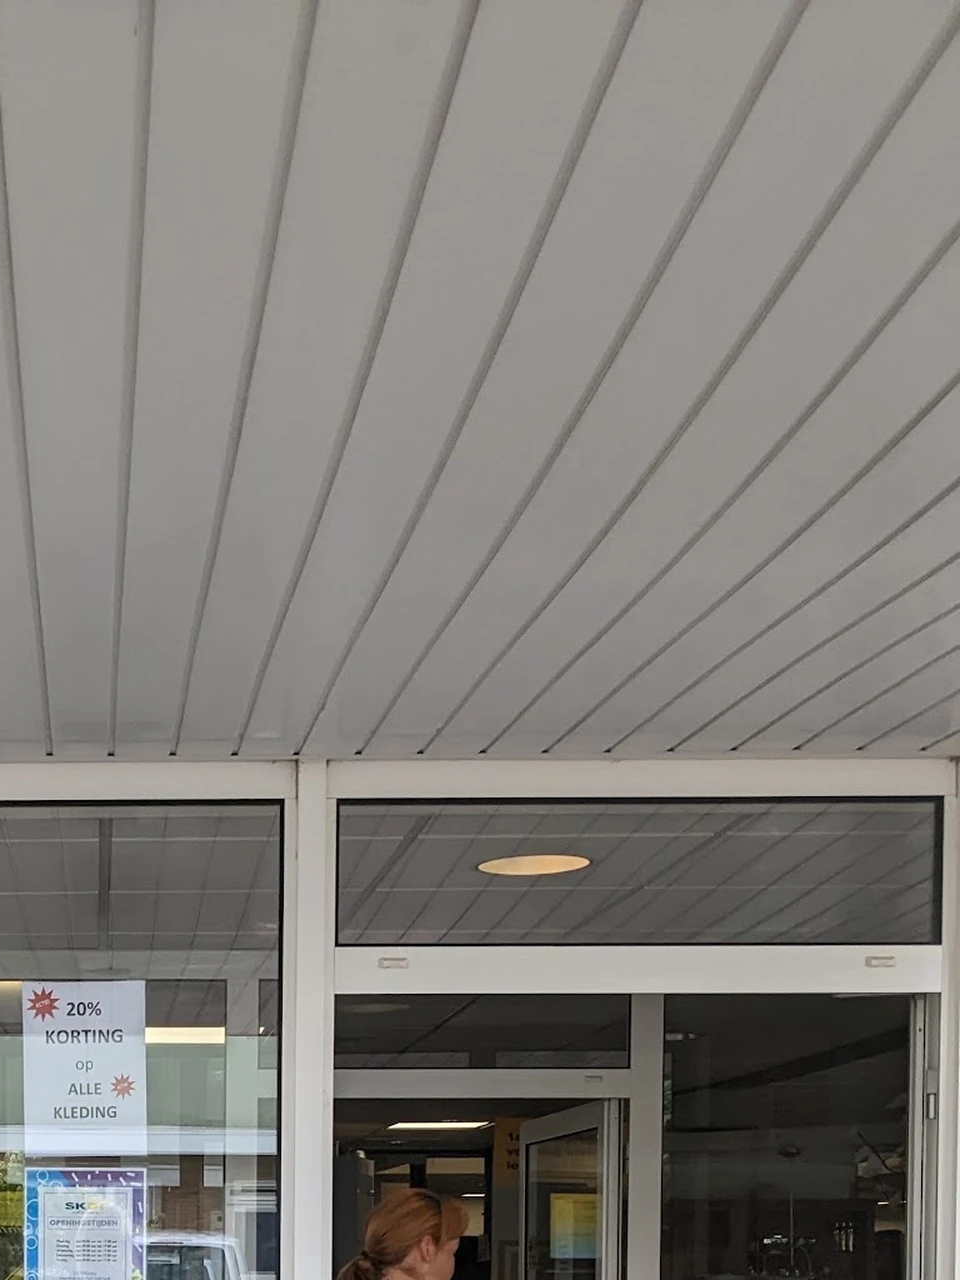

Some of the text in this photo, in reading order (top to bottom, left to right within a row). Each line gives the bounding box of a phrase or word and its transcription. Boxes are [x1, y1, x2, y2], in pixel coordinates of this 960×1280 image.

[66, 1001, 102, 1017] 20%
[45, 1029, 124, 1044] KORTING
[75, 1060, 94, 1073] op
[68, 1083, 102, 1095] ALLE
[53, 1106, 118, 1119] KLEDING
[49, 1219, 118, 1227] OPENINGSTIJDEN
